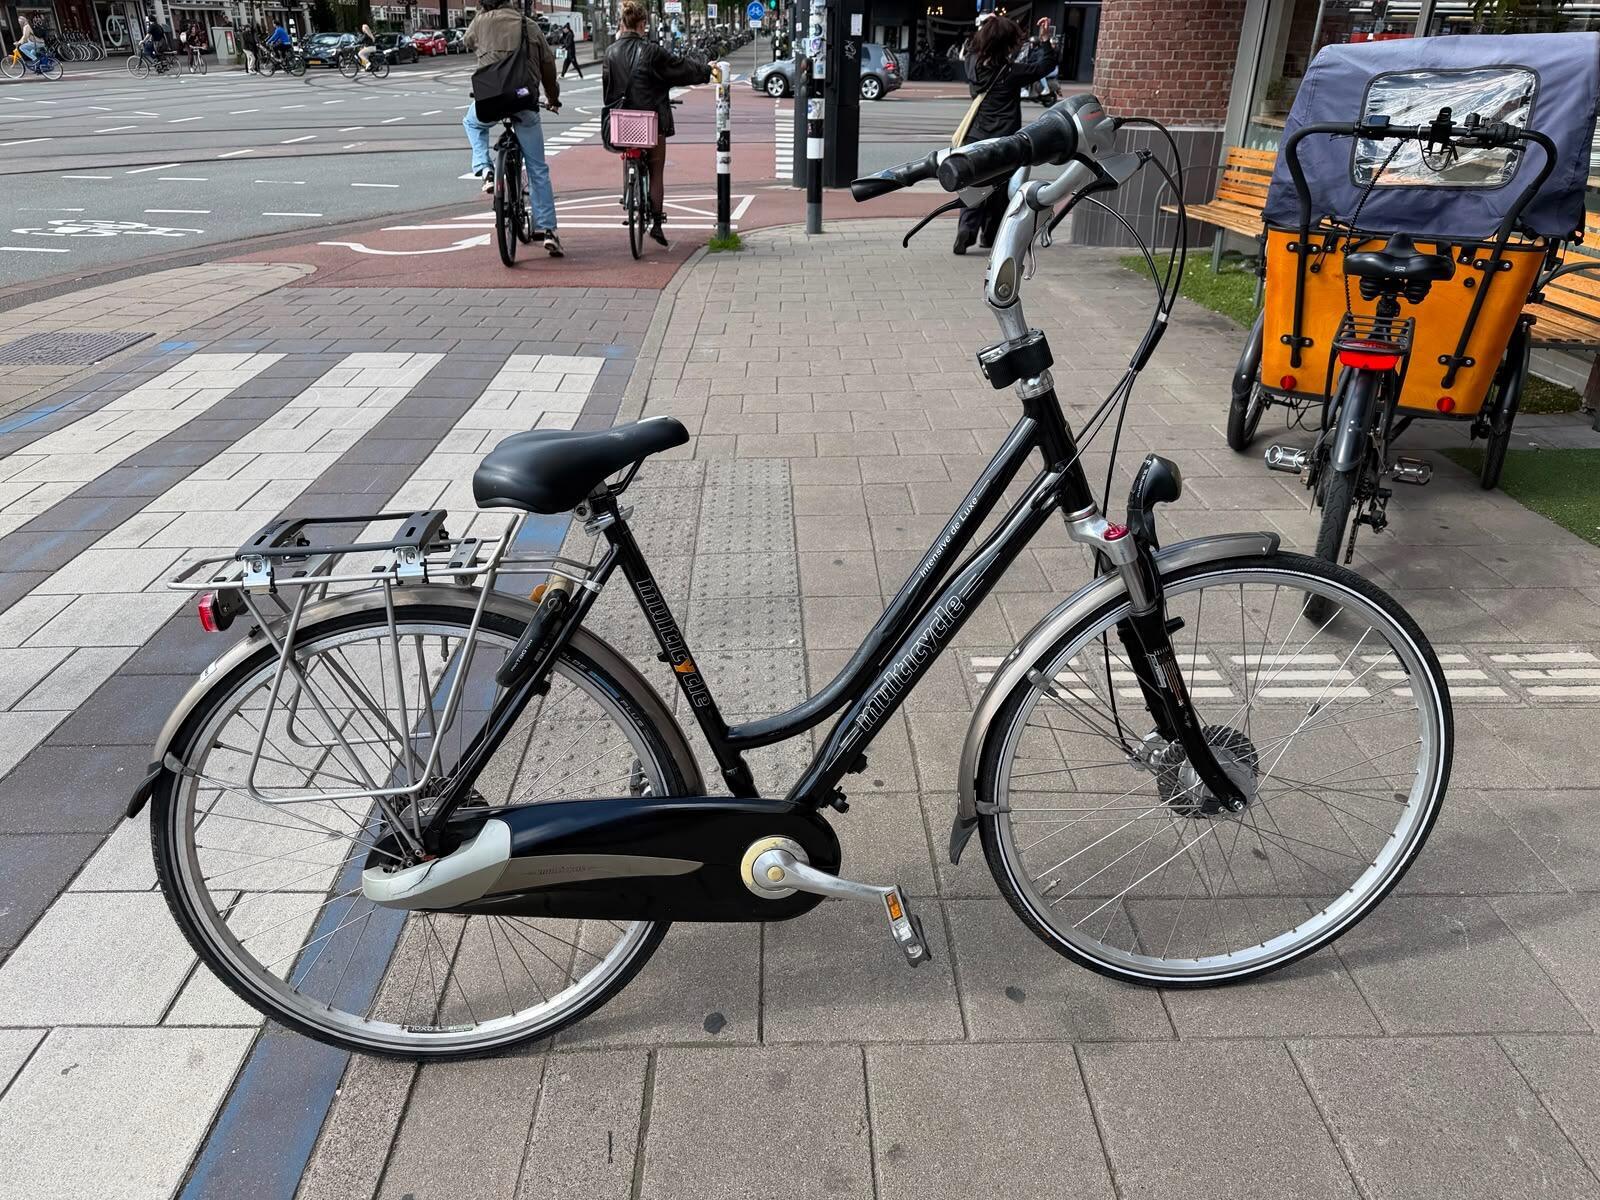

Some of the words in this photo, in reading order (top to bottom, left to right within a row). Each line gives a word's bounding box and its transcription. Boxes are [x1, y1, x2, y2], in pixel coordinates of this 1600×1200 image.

[919, 535, 951, 578] Intensive
[950, 521, 961, 536] de
[959, 497, 978, 522] Luxe
[636, 577, 711, 708] multicycle
[855, 595, 966, 732] multicycle
